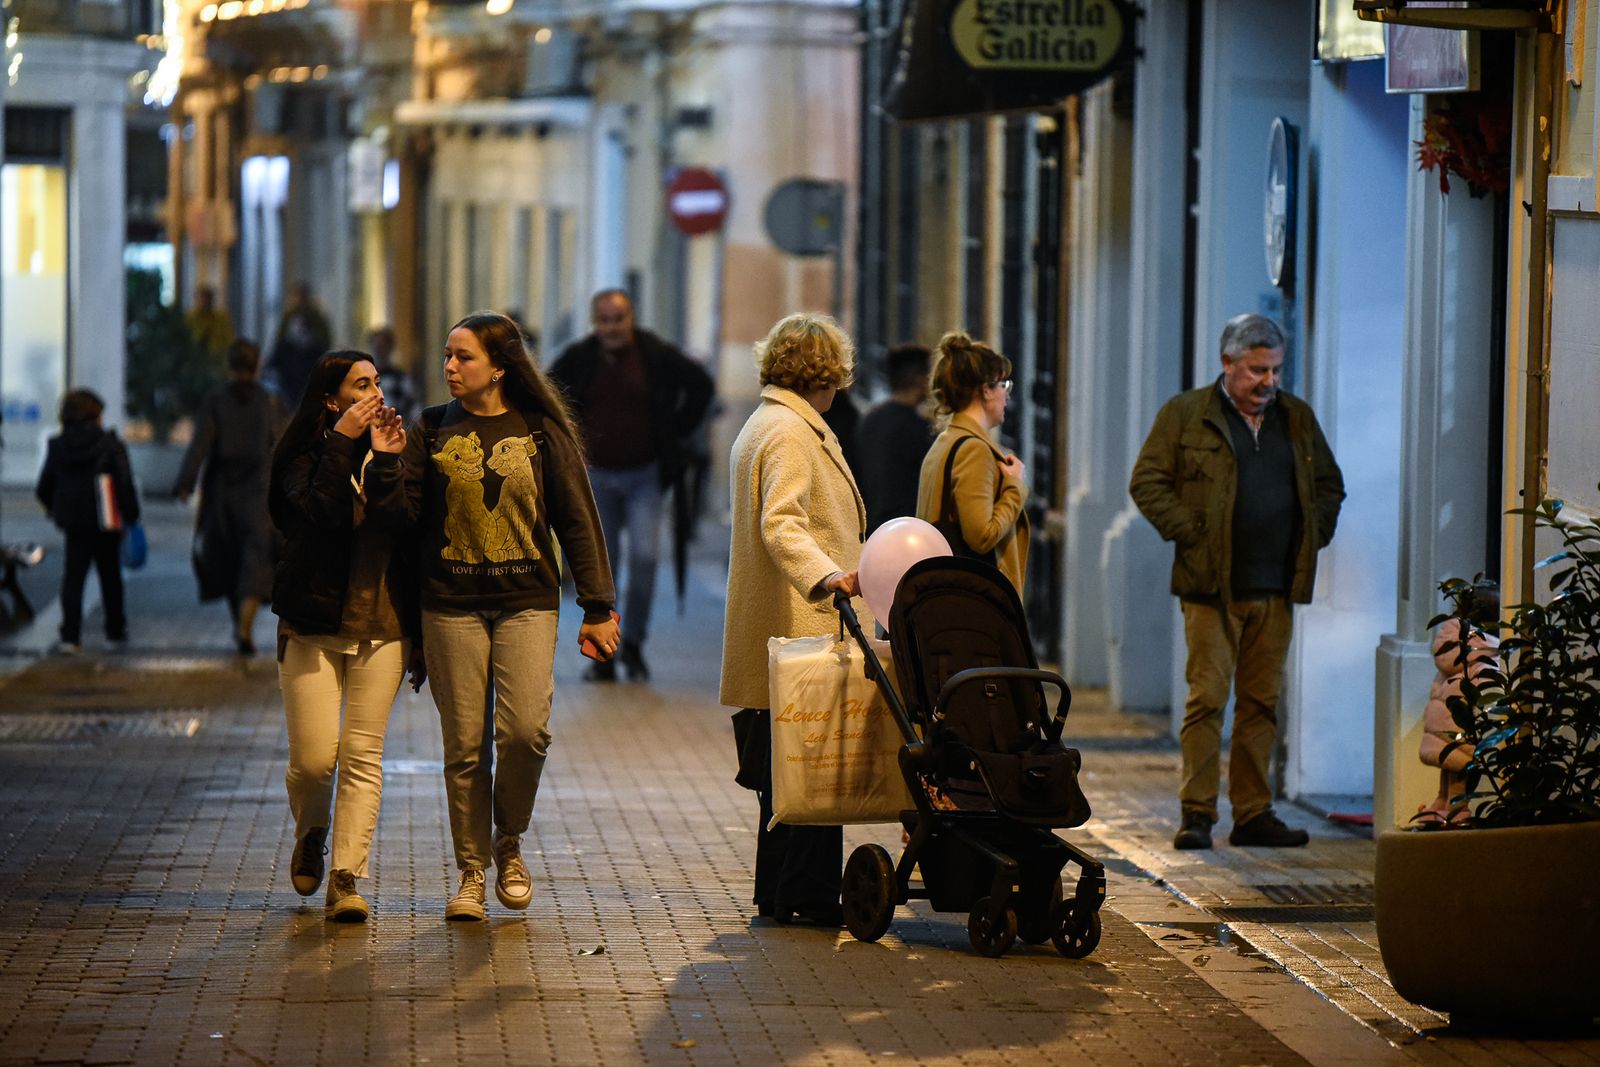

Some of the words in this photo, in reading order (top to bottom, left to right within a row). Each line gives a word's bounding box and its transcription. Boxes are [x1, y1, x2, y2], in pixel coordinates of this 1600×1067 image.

[974, 0, 1105, 26] Estrella
[977, 28, 1097, 61] Galicia
[452, 566, 473, 575] LOVE
[487, 566, 509, 577] FIRST
[511, 565, 537, 574] SIGHT
[840, 699, 890, 724] Hoga
